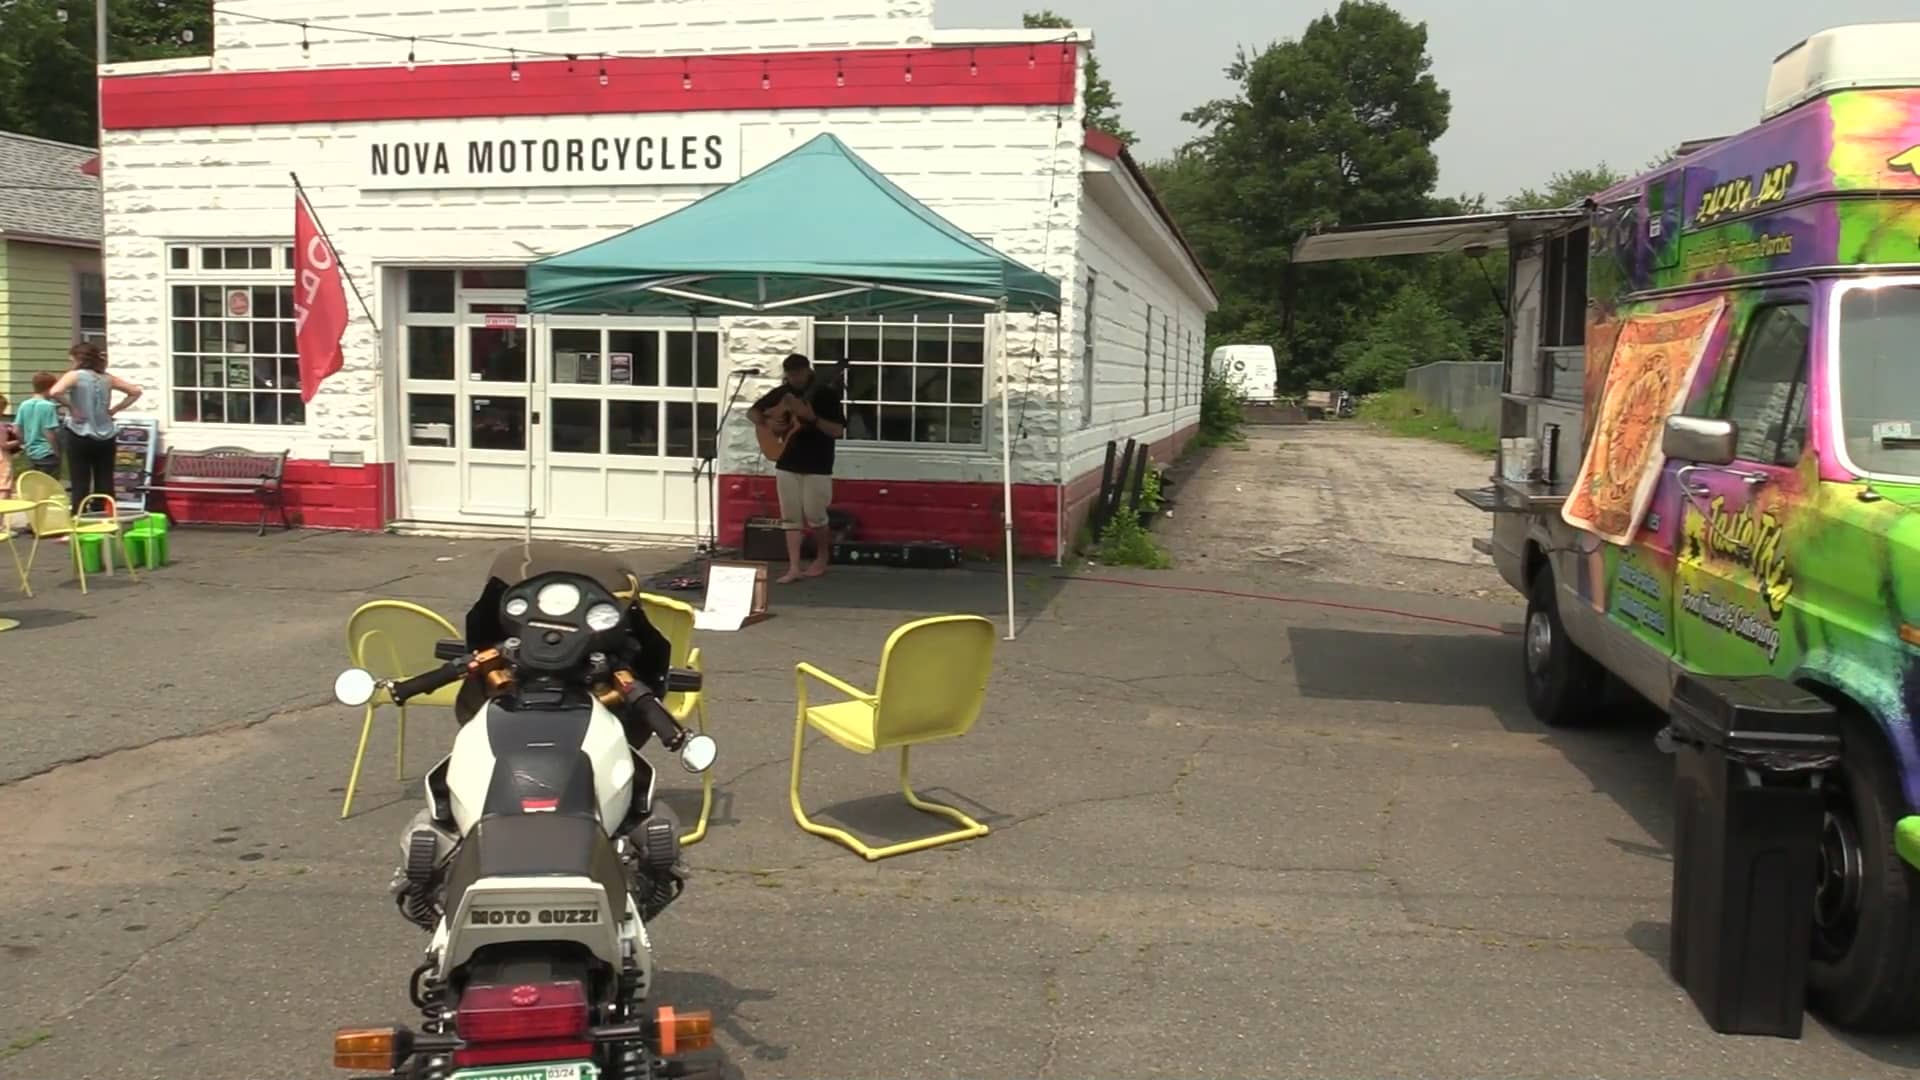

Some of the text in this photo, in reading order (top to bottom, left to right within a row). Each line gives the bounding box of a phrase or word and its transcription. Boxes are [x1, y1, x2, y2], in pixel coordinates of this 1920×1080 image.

[371, 135, 723, 176] NOVA MOTORCYCLES
[471, 909, 599, 925] MOTO GUZZI
[548, 1068, 575, 1079] 03/24
